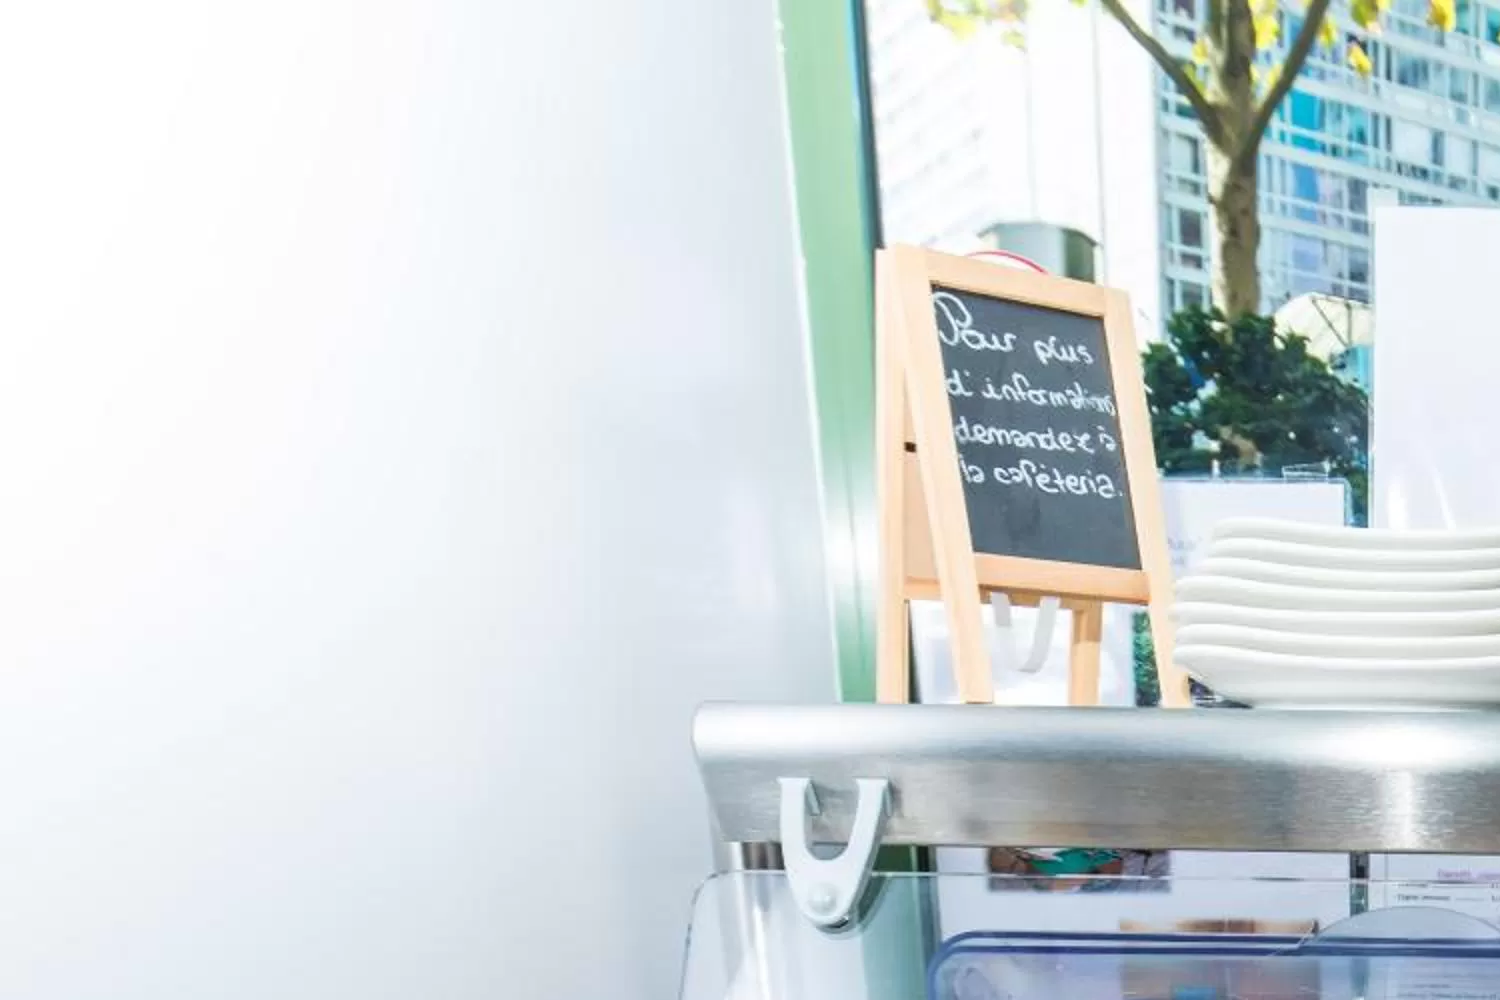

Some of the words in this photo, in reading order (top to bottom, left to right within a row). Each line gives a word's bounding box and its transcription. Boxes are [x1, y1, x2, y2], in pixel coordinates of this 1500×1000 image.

[932, 291, 1017, 353] Pour
[1033, 335, 1094, 366] plus
[955, 415, 1095, 454] demandez
[959, 454, 985, 484] la
